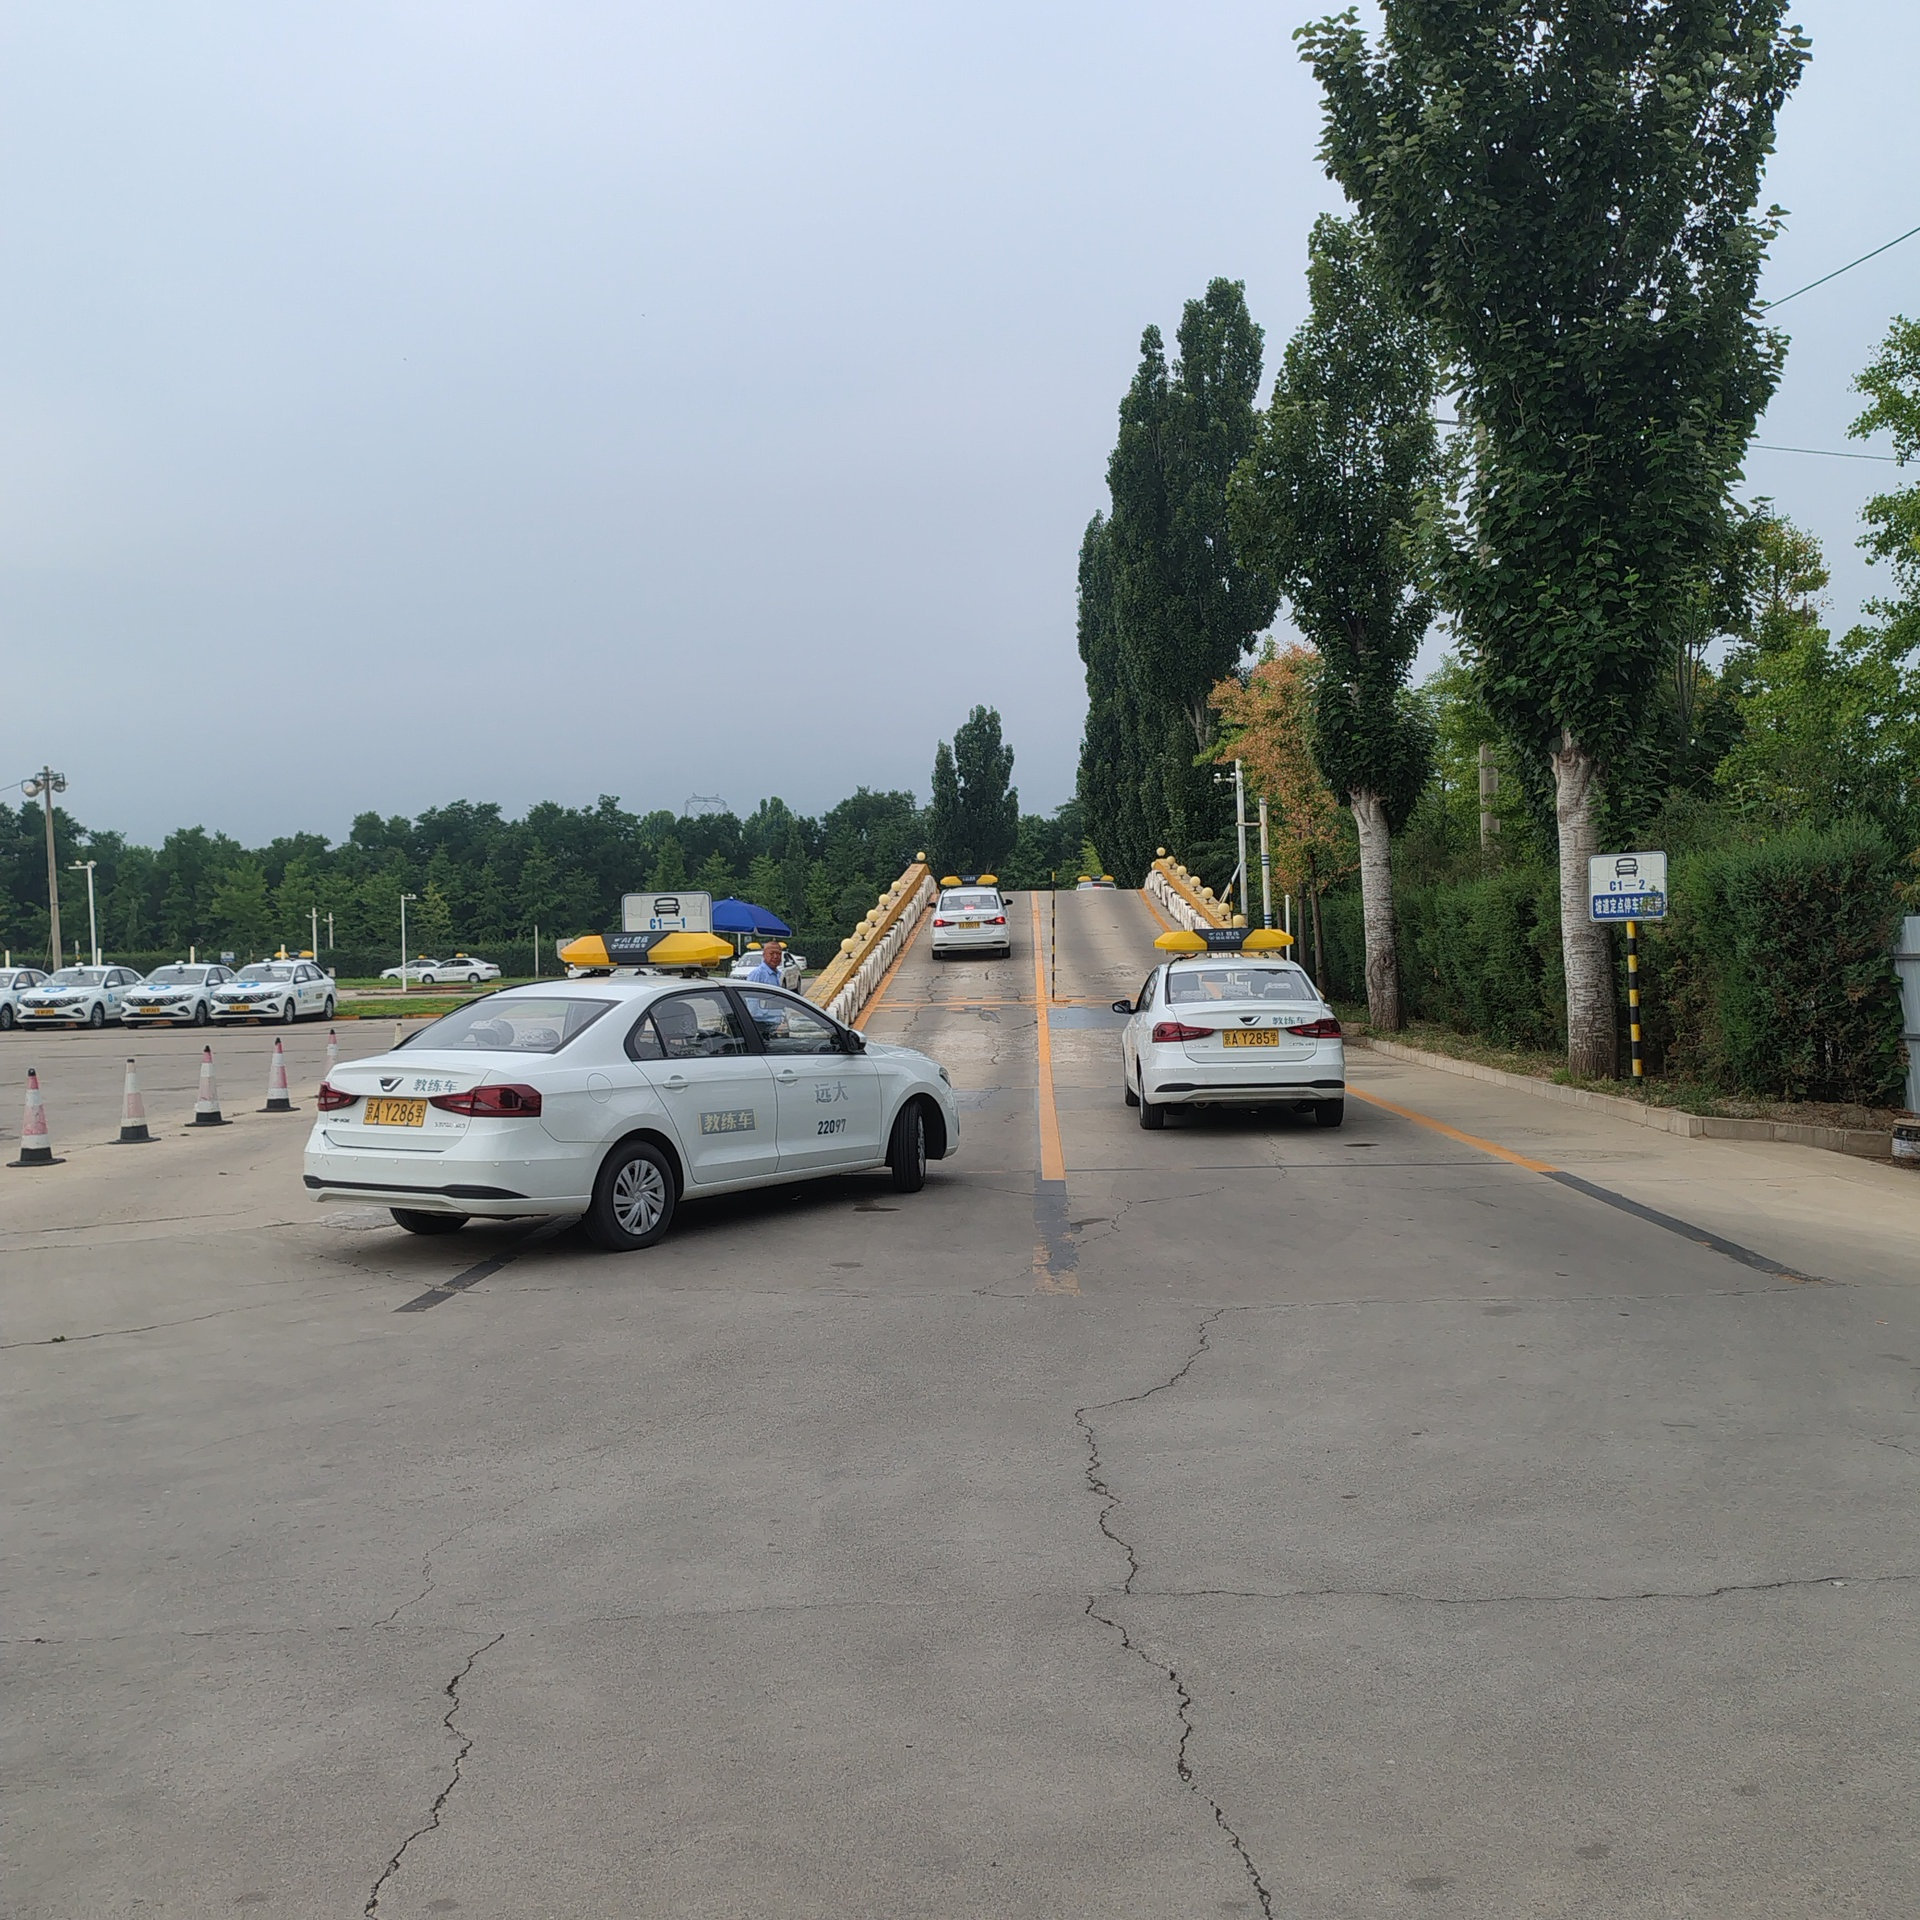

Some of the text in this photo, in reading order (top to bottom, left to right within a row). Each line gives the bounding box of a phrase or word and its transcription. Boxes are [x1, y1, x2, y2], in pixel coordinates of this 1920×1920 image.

[1595, 896, 1663, 914] 坡道定点停车
[413, 1078, 459, 1093] 教练车
[814, 1081, 849, 1104] 远大
[704, 1111, 753, 1132] 教练车
[816, 1118, 847, 1136] 22097
